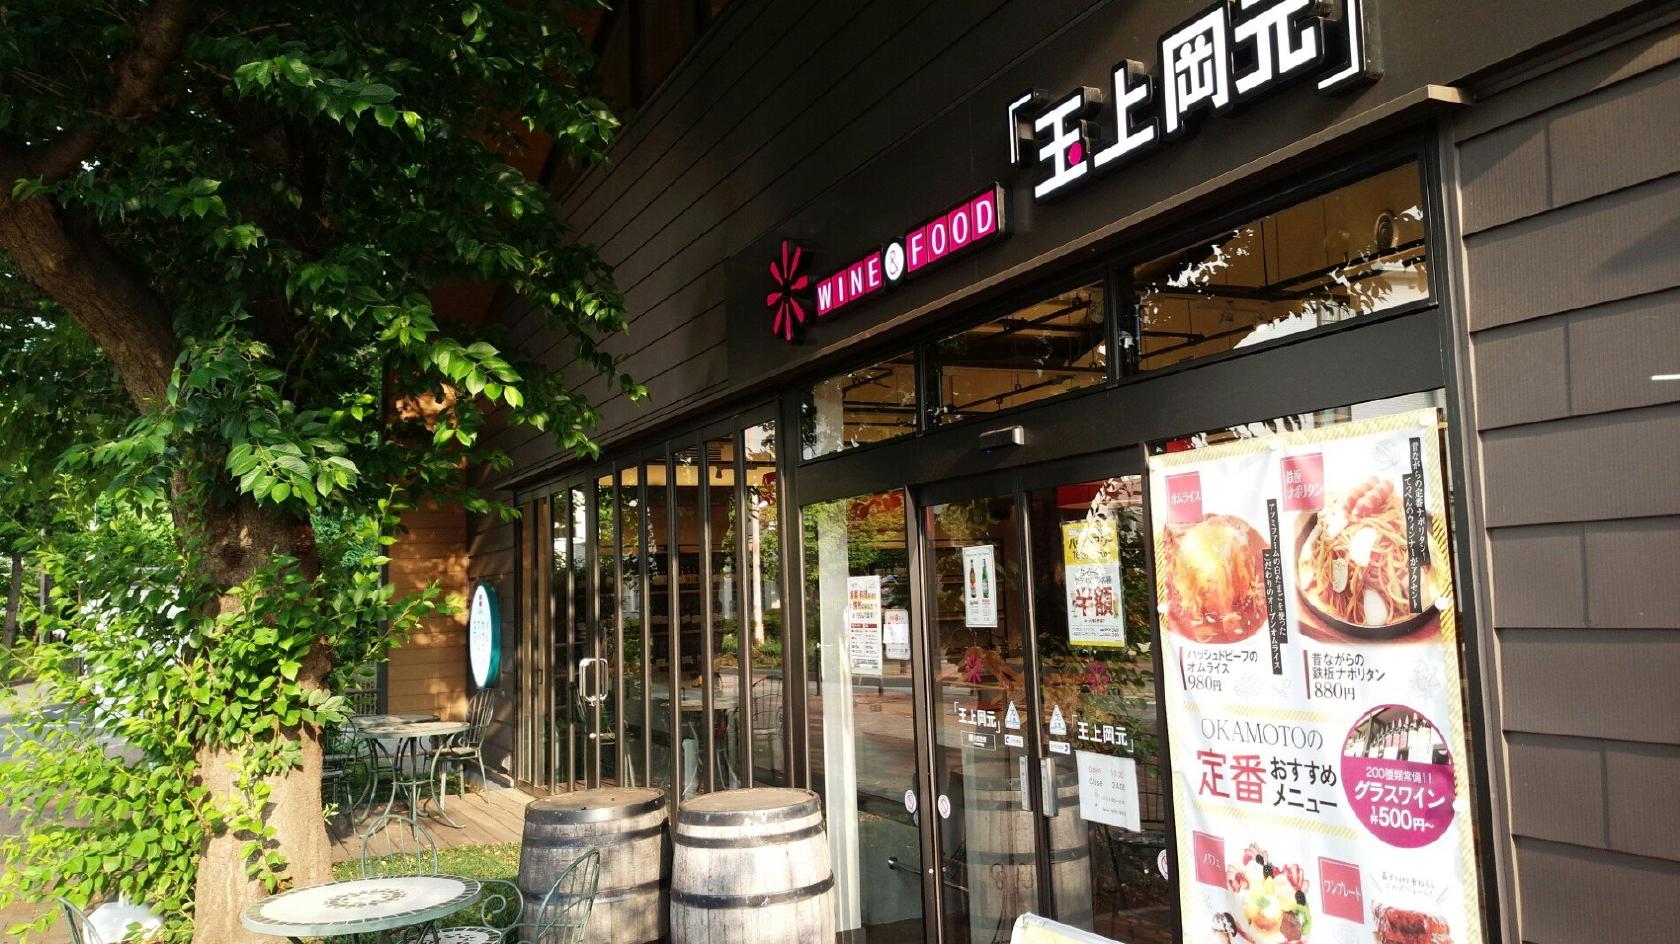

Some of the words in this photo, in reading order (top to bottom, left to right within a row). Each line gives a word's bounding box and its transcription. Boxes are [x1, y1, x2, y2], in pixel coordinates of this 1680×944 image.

[817, 257, 880, 311] WINE
[911, 200, 993, 266] FOOD
[1188, 650, 1258, 662] ハッシュドビーフの
[1312, 653, 1364, 666] 昔ながらの
[1187, 662, 1229, 674] オムライス
[1312, 667, 1386, 681] 鉄板ナポリタン
[1187, 674, 1222, 692] 980円
[1314, 682, 1355, 700] 880円
[1201, 718, 1323, 750] OKAMOTOの
[1197, 748, 1266, 804] 定番
[1270, 756, 1337, 787] おすすめ
[1273, 784, 1337, 813] メニュー
[1355, 780, 1445, 808] グラスワイン
